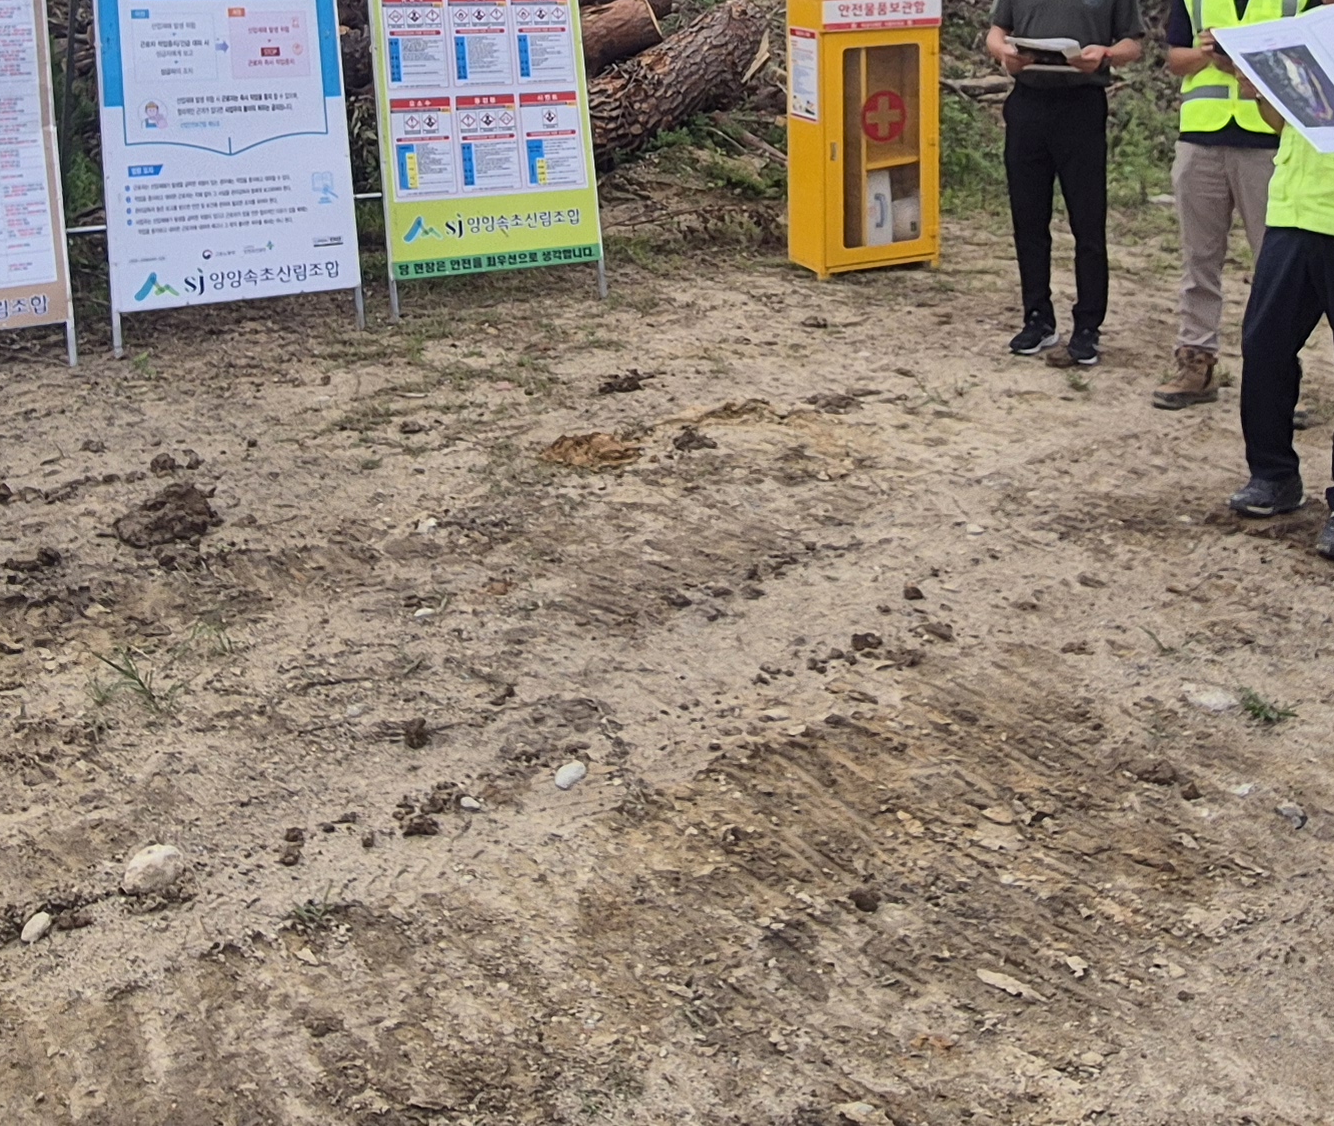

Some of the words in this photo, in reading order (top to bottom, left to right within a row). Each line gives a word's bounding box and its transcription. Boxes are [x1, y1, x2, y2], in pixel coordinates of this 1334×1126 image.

[838, 1, 925, 18] 안전물품보관함
[467, 208, 580, 235] 양양속초산림조합
[209, 260, 340, 289] 양양속초산림조합
[398, 265, 410, 275] 당
[414, 261, 447, 274] 현장은
[450, 257, 483, 271] 안전을
[486, 251, 539, 268] 최우선으로
[542, 246, 595, 262] 생각합니다.
